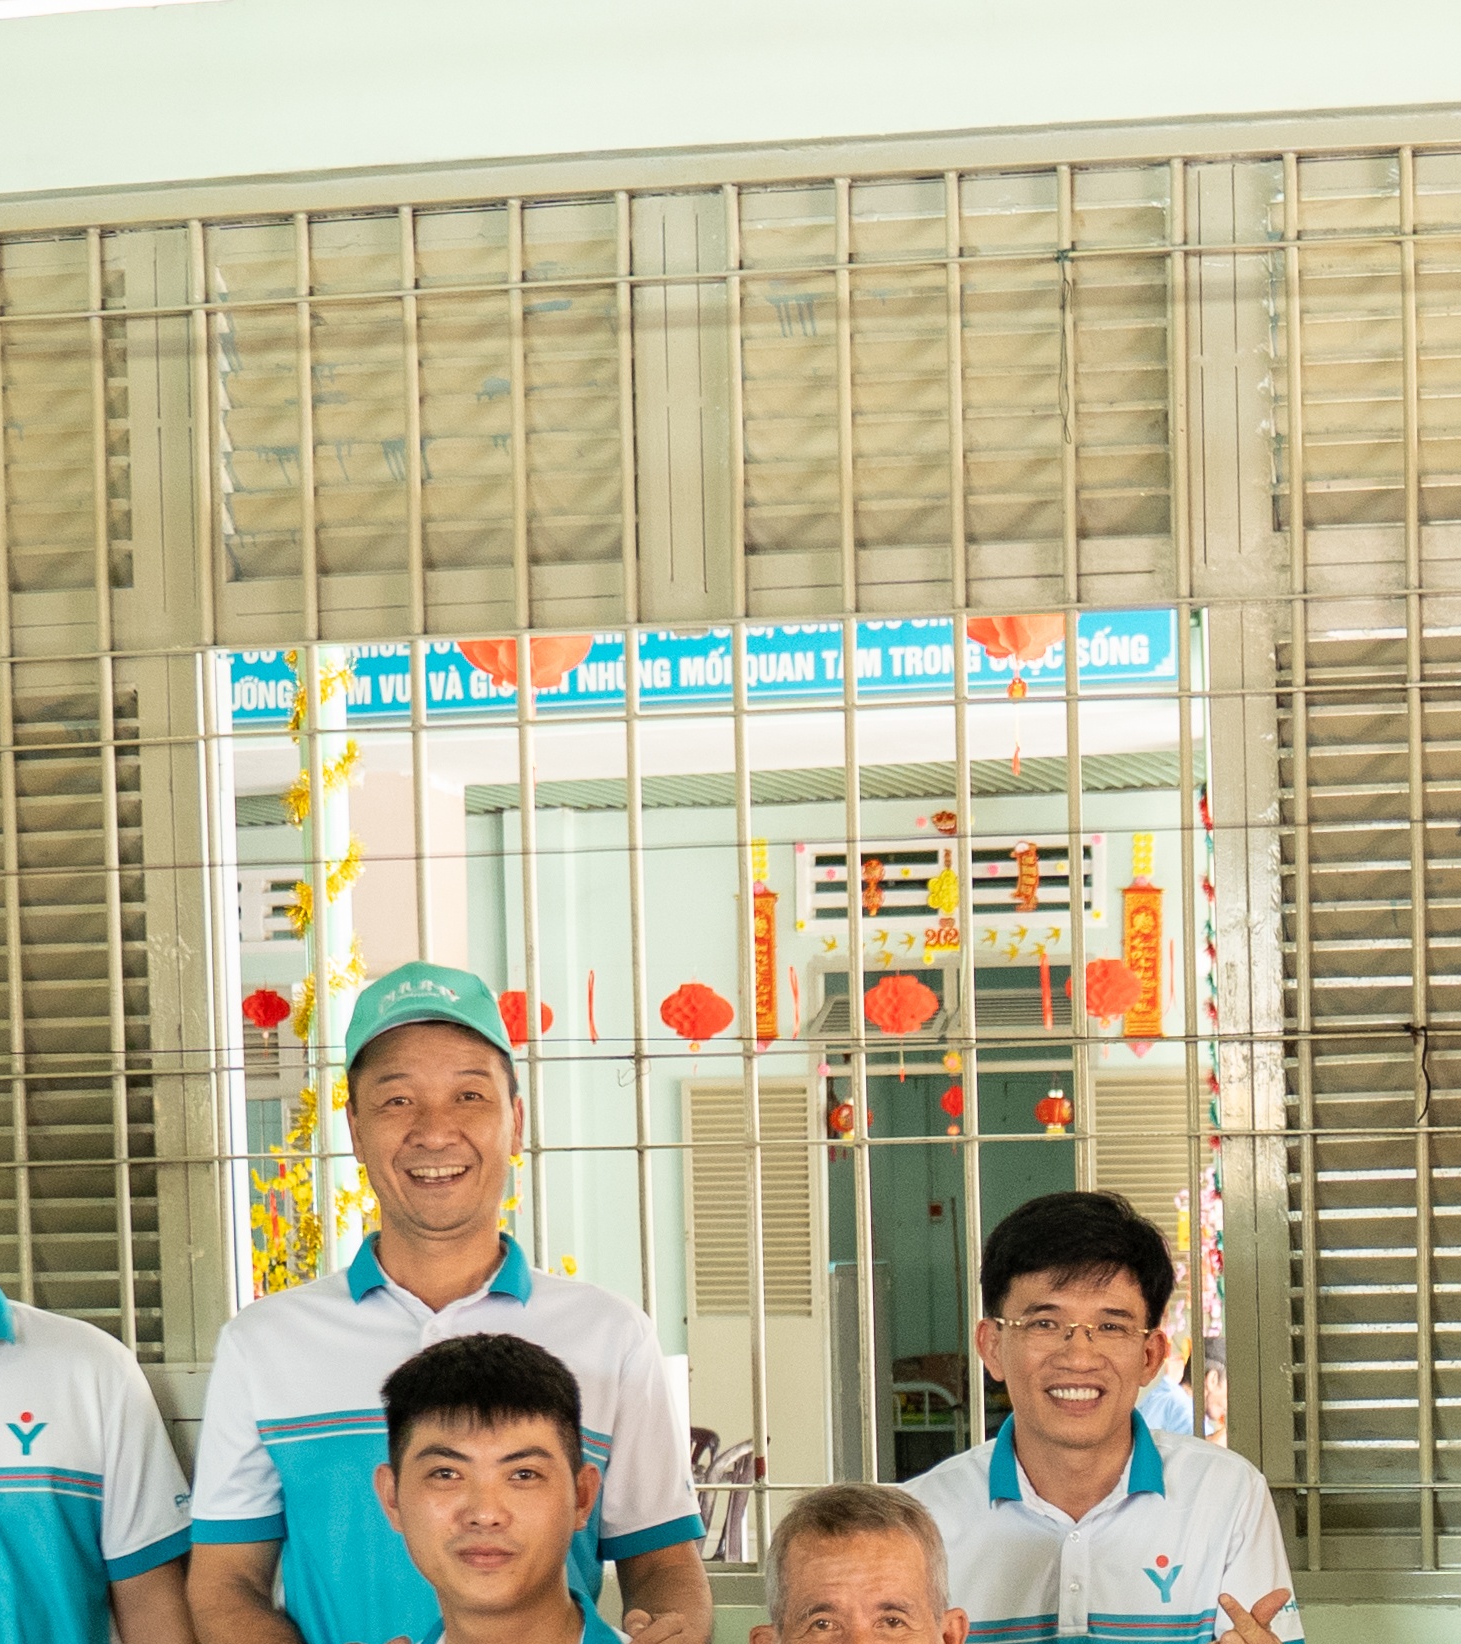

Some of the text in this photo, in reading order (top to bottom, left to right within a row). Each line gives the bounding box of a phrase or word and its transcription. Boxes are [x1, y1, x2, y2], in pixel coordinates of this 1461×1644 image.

[428, 664, 464, 701] VÀ
[679, 646, 733, 688] MỐI
[746, 651, 815, 687] QUAN
[890, 643, 981, 677] TRONG
[1077, 626, 1150, 667] SỐNG
[924, 928, 960, 947] 202
